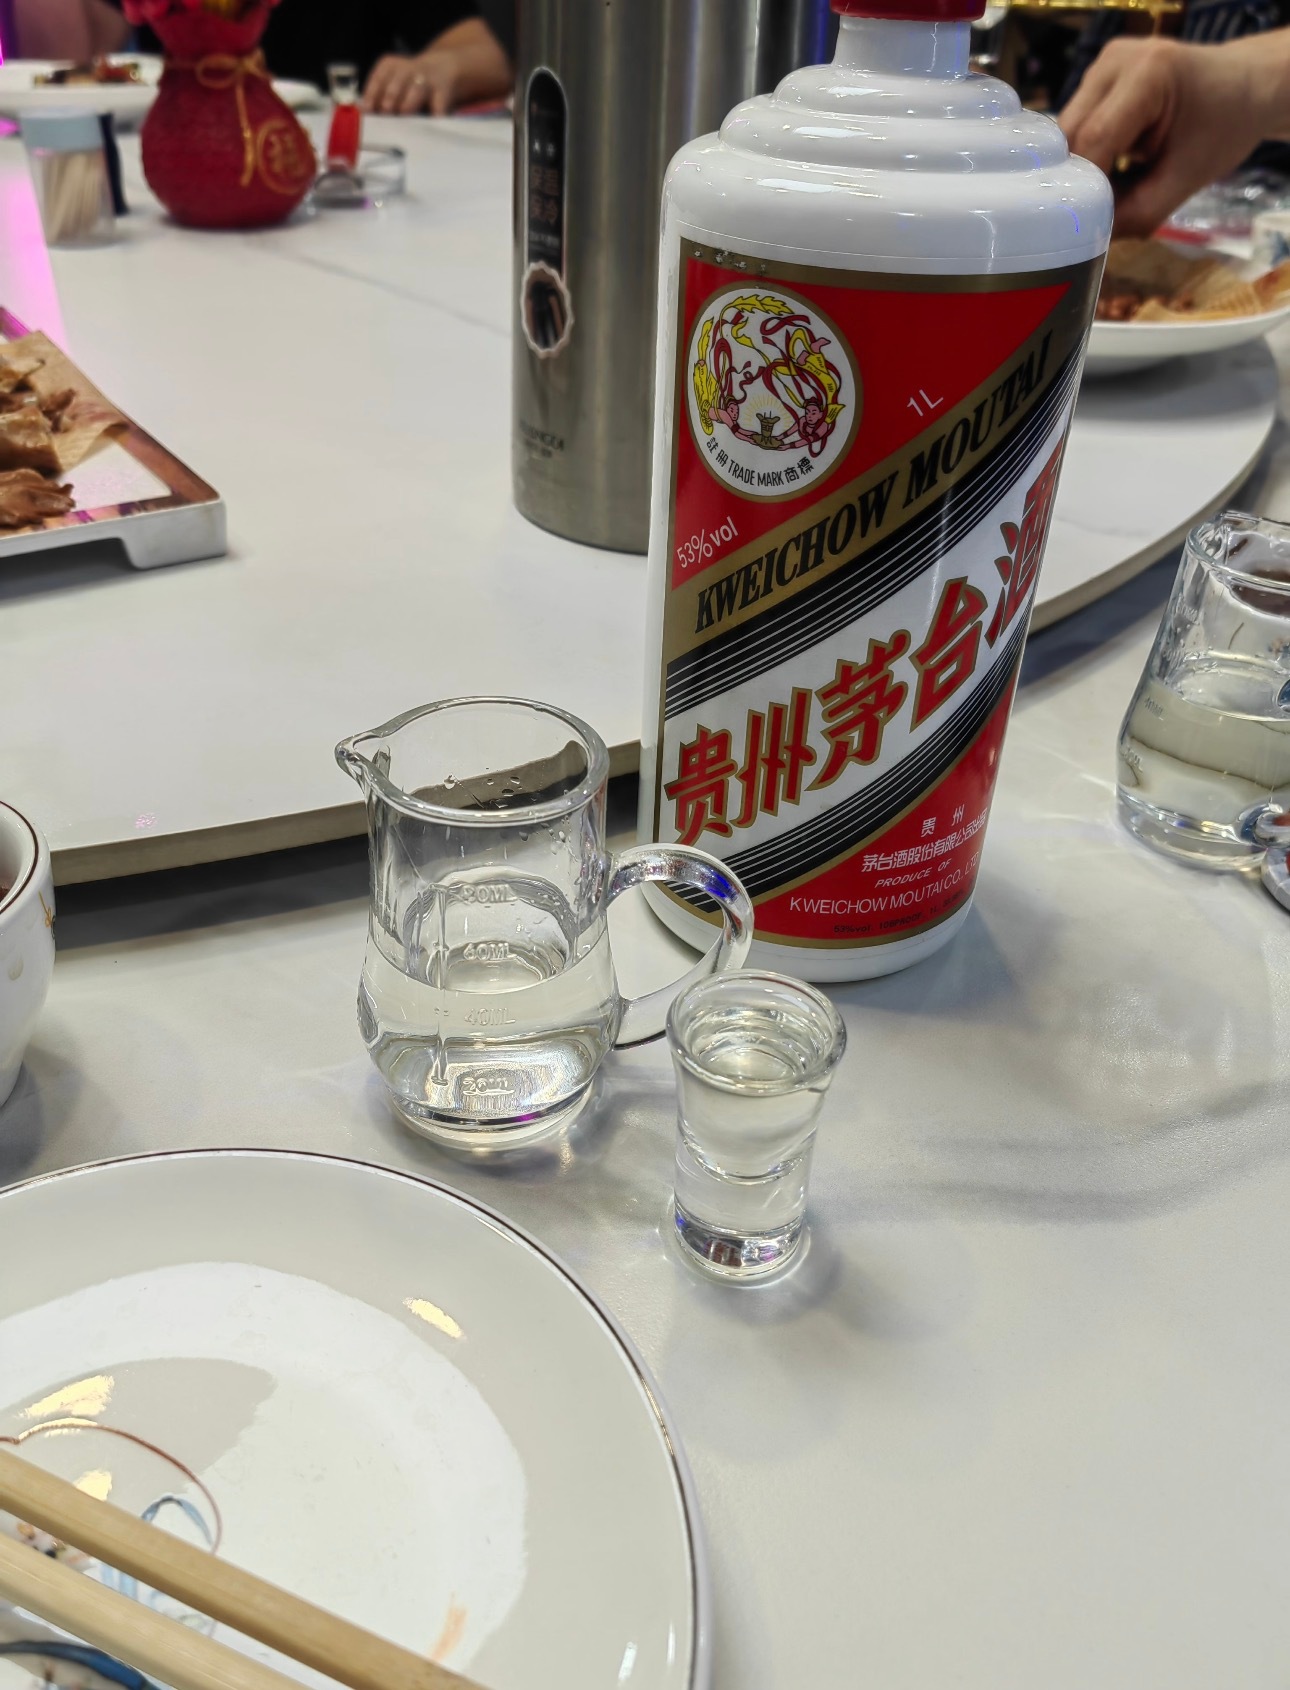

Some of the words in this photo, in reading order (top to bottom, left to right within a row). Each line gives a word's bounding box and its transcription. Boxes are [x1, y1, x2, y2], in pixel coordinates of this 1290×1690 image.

[907, 389, 943, 416] 1L
[695, 470, 899, 633] KWEICHOW
[902, 329, 1053, 508] MOUTAI
[728, 459, 755, 485] TRADE
[757, 471, 784, 486] MARK
[875, 867, 932, 888] PRODUCE
[938, 858, 951, 871] OF
[789, 897, 888, 914] KWEICHOW
[890, 880, 943, 909] MOUTAI
